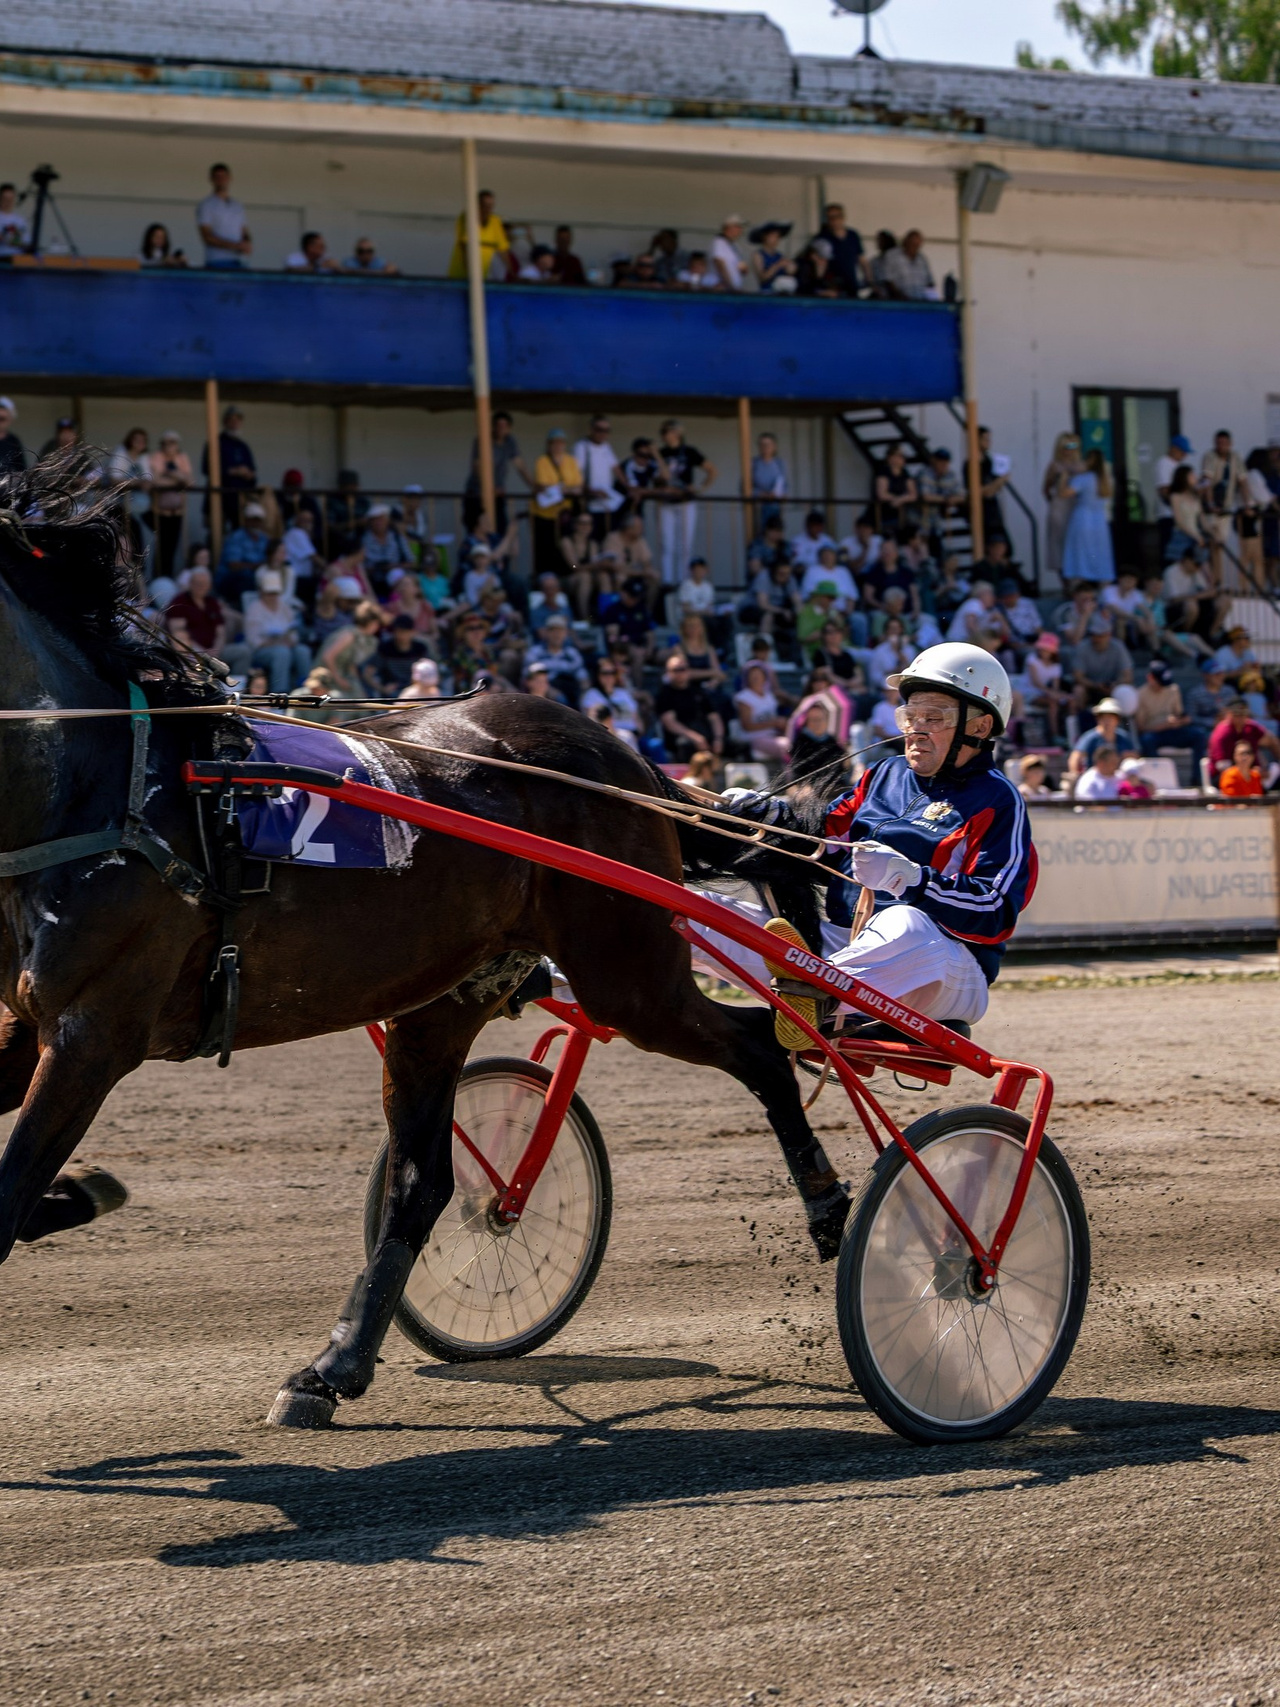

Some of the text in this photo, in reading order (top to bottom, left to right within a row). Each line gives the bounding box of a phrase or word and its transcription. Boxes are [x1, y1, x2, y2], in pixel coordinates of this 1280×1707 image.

[269, 786, 336, 863] 2
[784, 946, 929, 1034] CUSTOM MULTIFLEX
